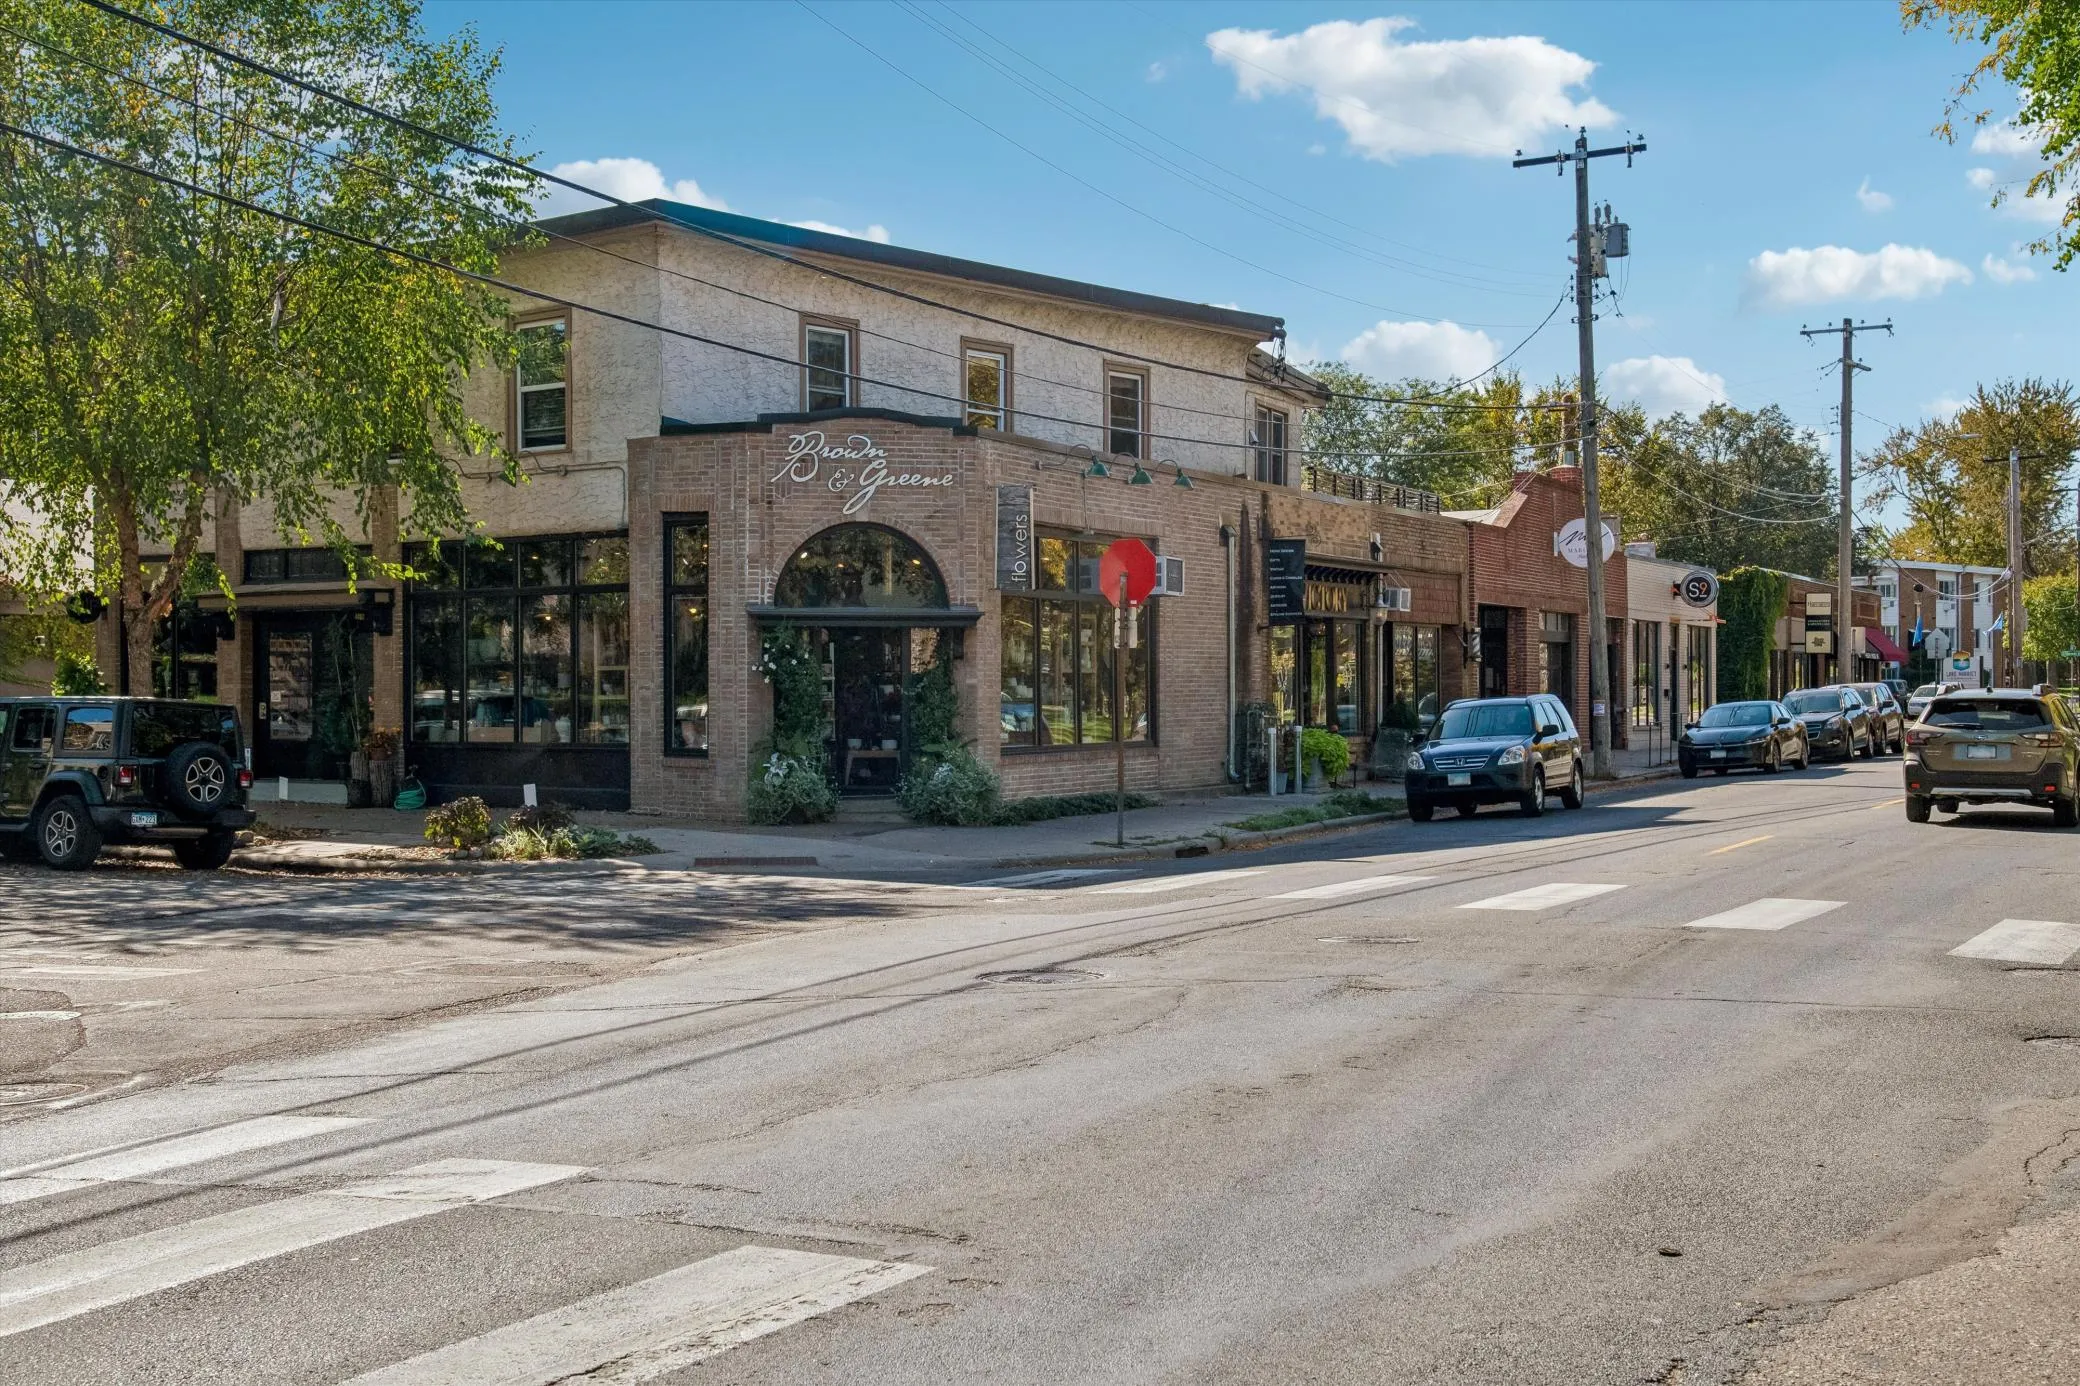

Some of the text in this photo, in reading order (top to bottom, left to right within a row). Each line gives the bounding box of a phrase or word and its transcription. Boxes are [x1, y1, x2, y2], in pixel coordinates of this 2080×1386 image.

[771, 431, 888, 482] Brown
[828, 459, 953, 514] & Greene
[1012, 514, 1028, 582] flowers
